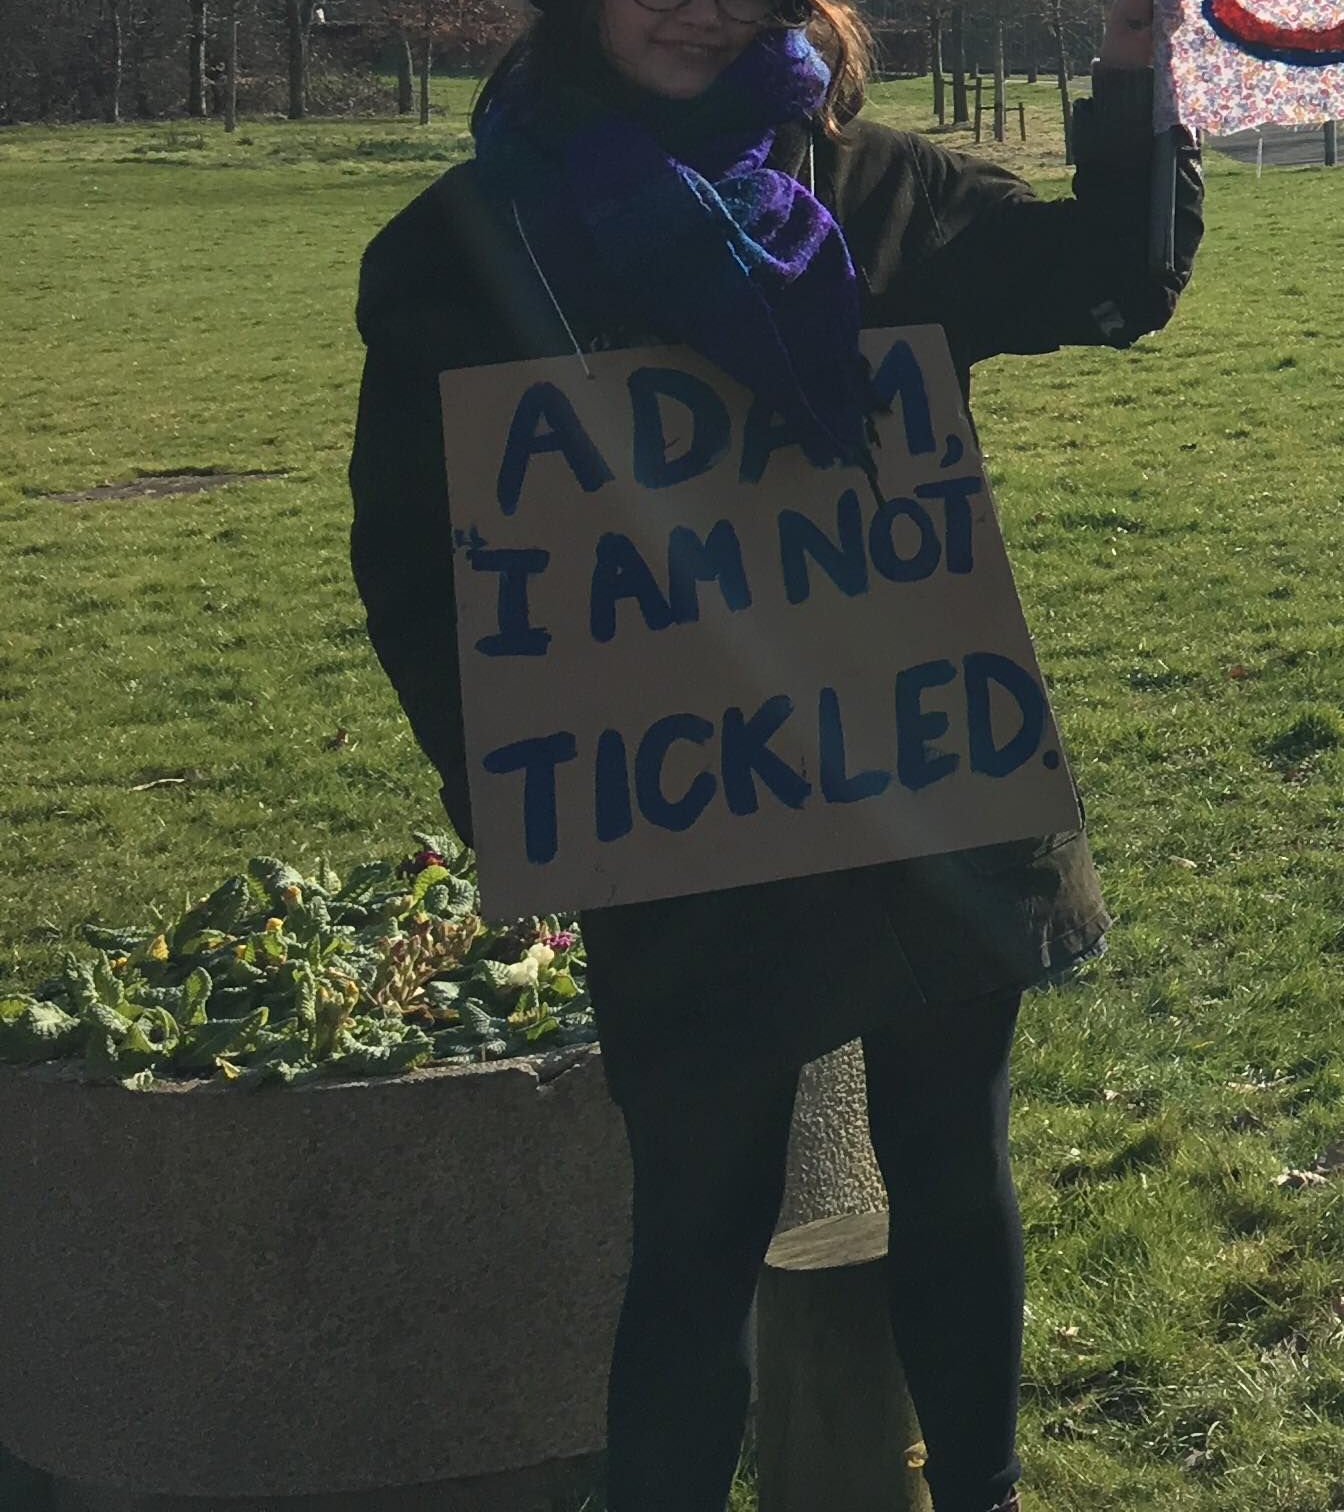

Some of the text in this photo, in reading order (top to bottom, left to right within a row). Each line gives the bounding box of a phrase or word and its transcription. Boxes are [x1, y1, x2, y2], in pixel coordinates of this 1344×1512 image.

[590, 518, 753, 644] AM
[776, 475, 983, 605] NOT
[481, 651, 1060, 865] TICKLED.
